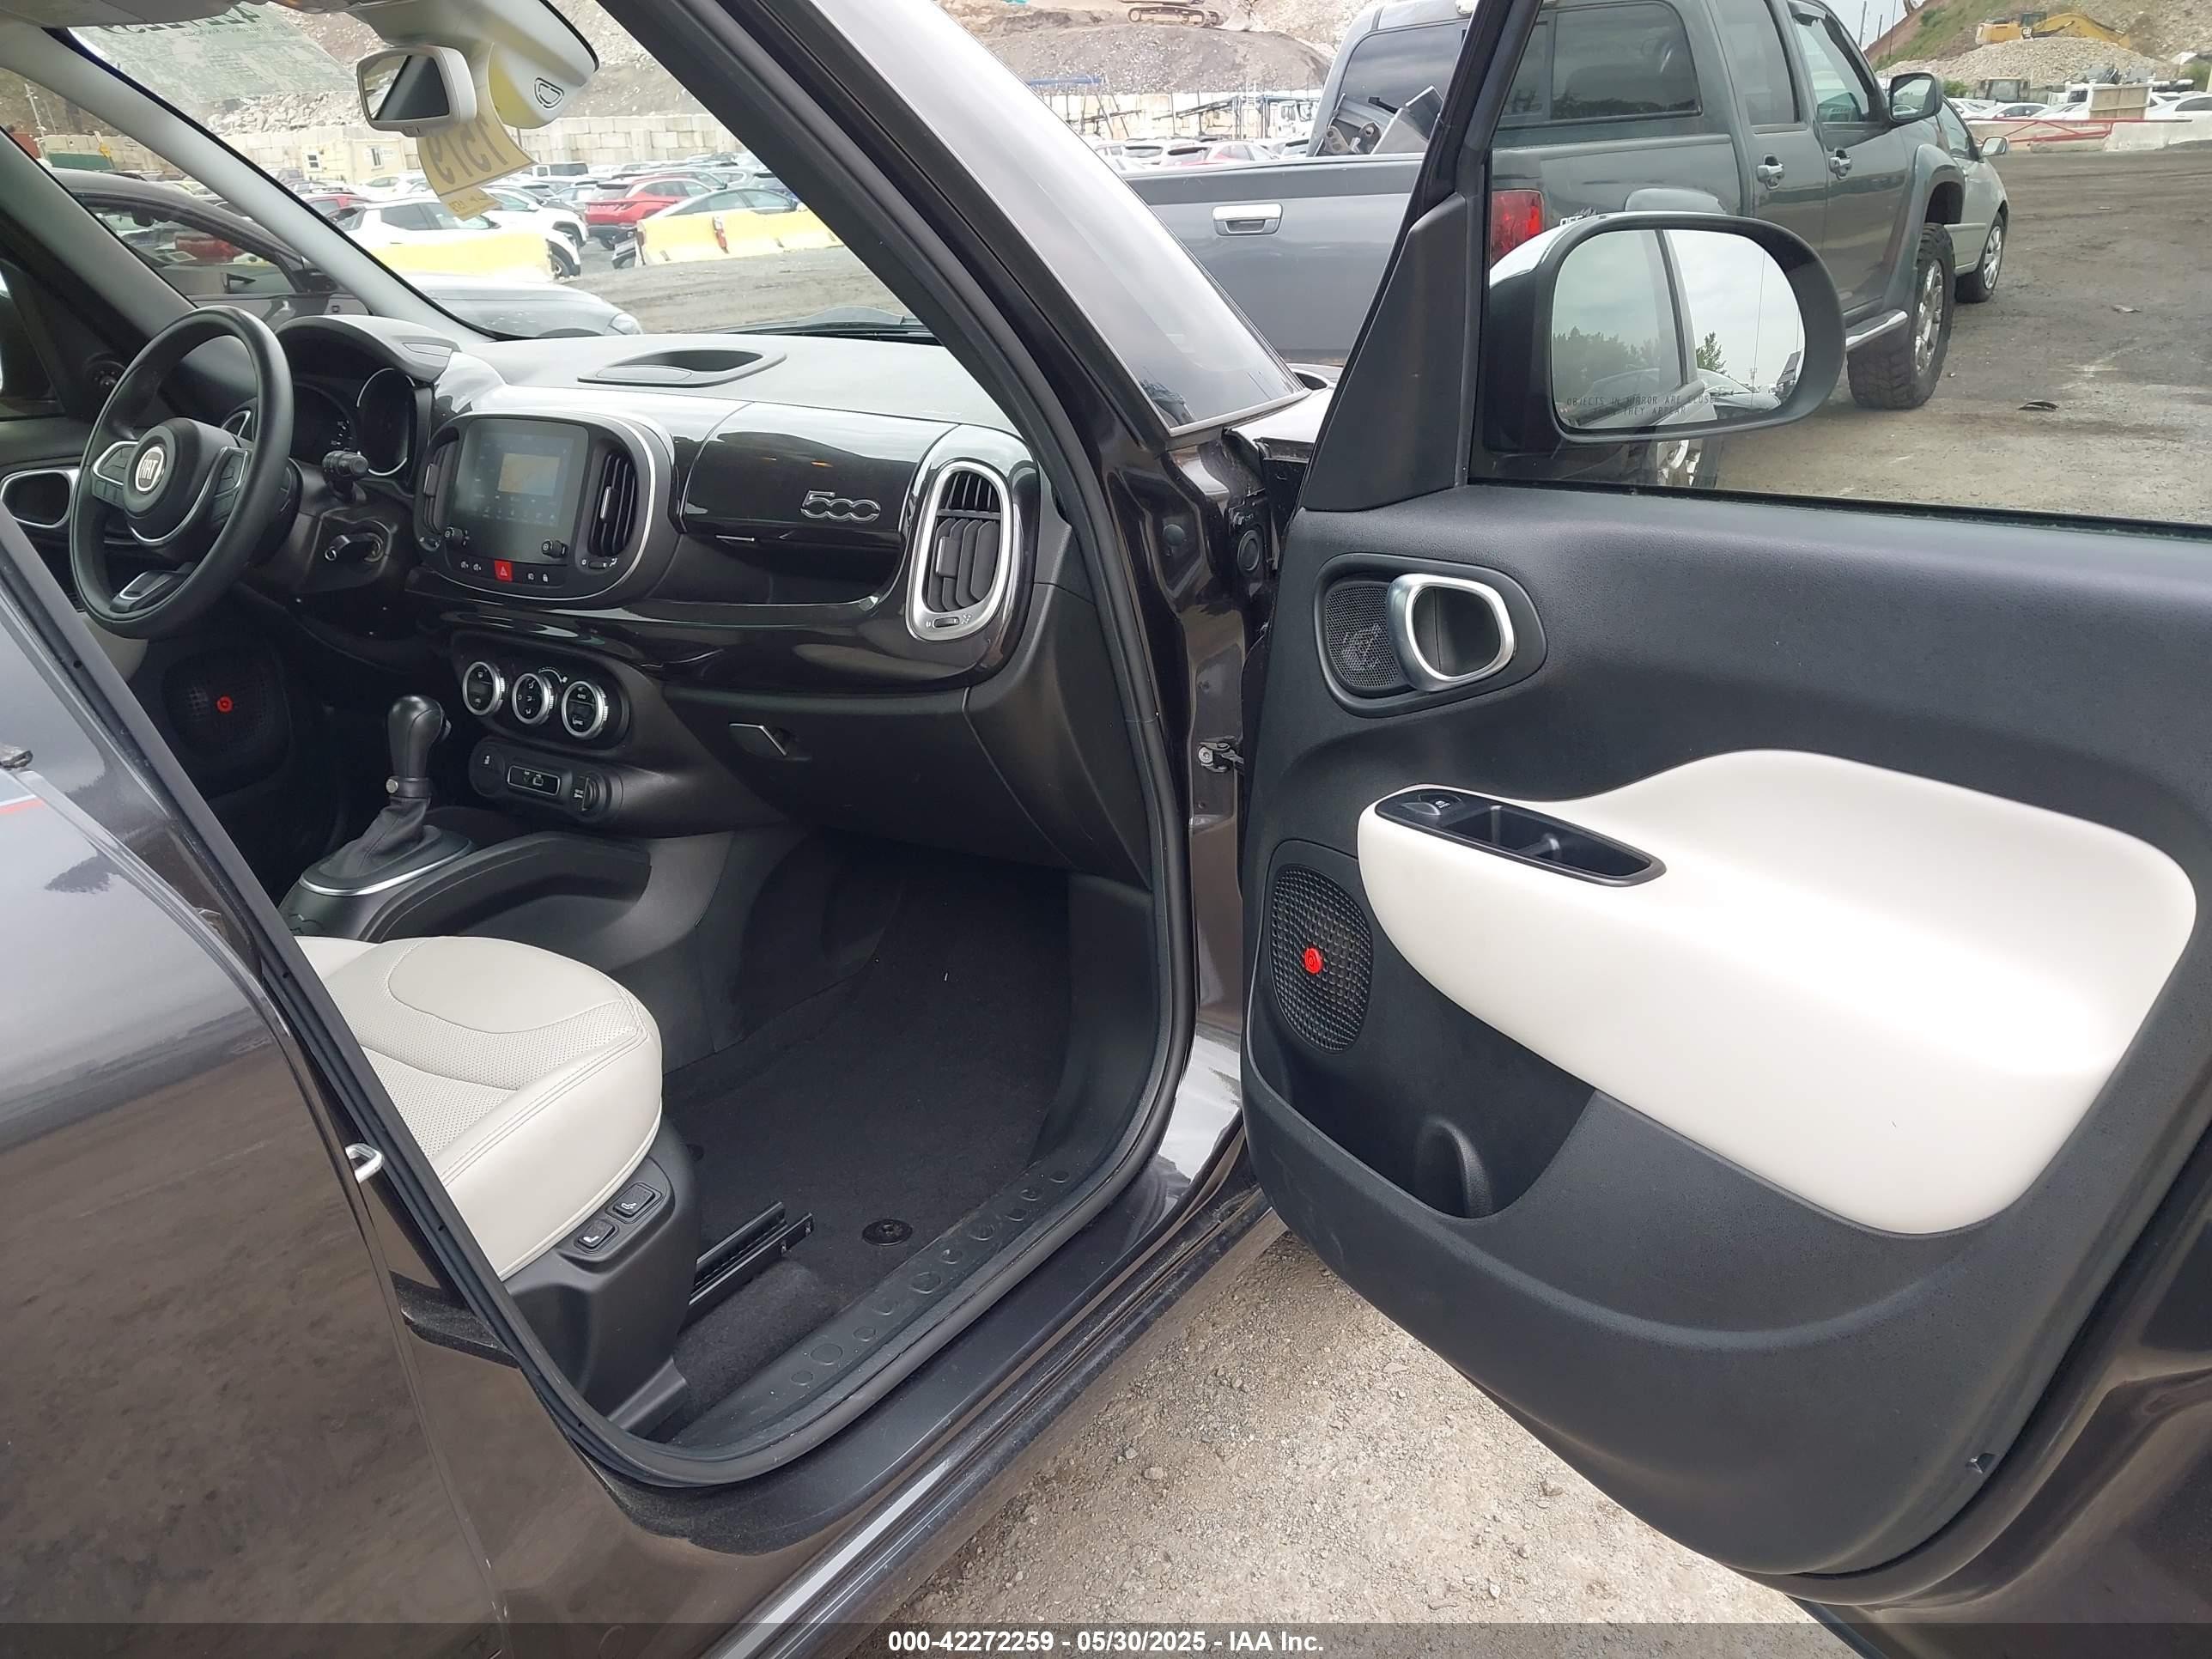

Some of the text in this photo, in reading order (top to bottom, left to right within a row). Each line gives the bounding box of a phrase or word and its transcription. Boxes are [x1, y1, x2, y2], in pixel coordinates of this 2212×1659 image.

[1566, 397, 1604, 406] OBJECTS
[1612, 397, 1620, 406] IN
[1626, 396, 1657, 405] MIRROR
[1664, 395, 1680, 404] ARE
[800, 490, 881, 523] 500
